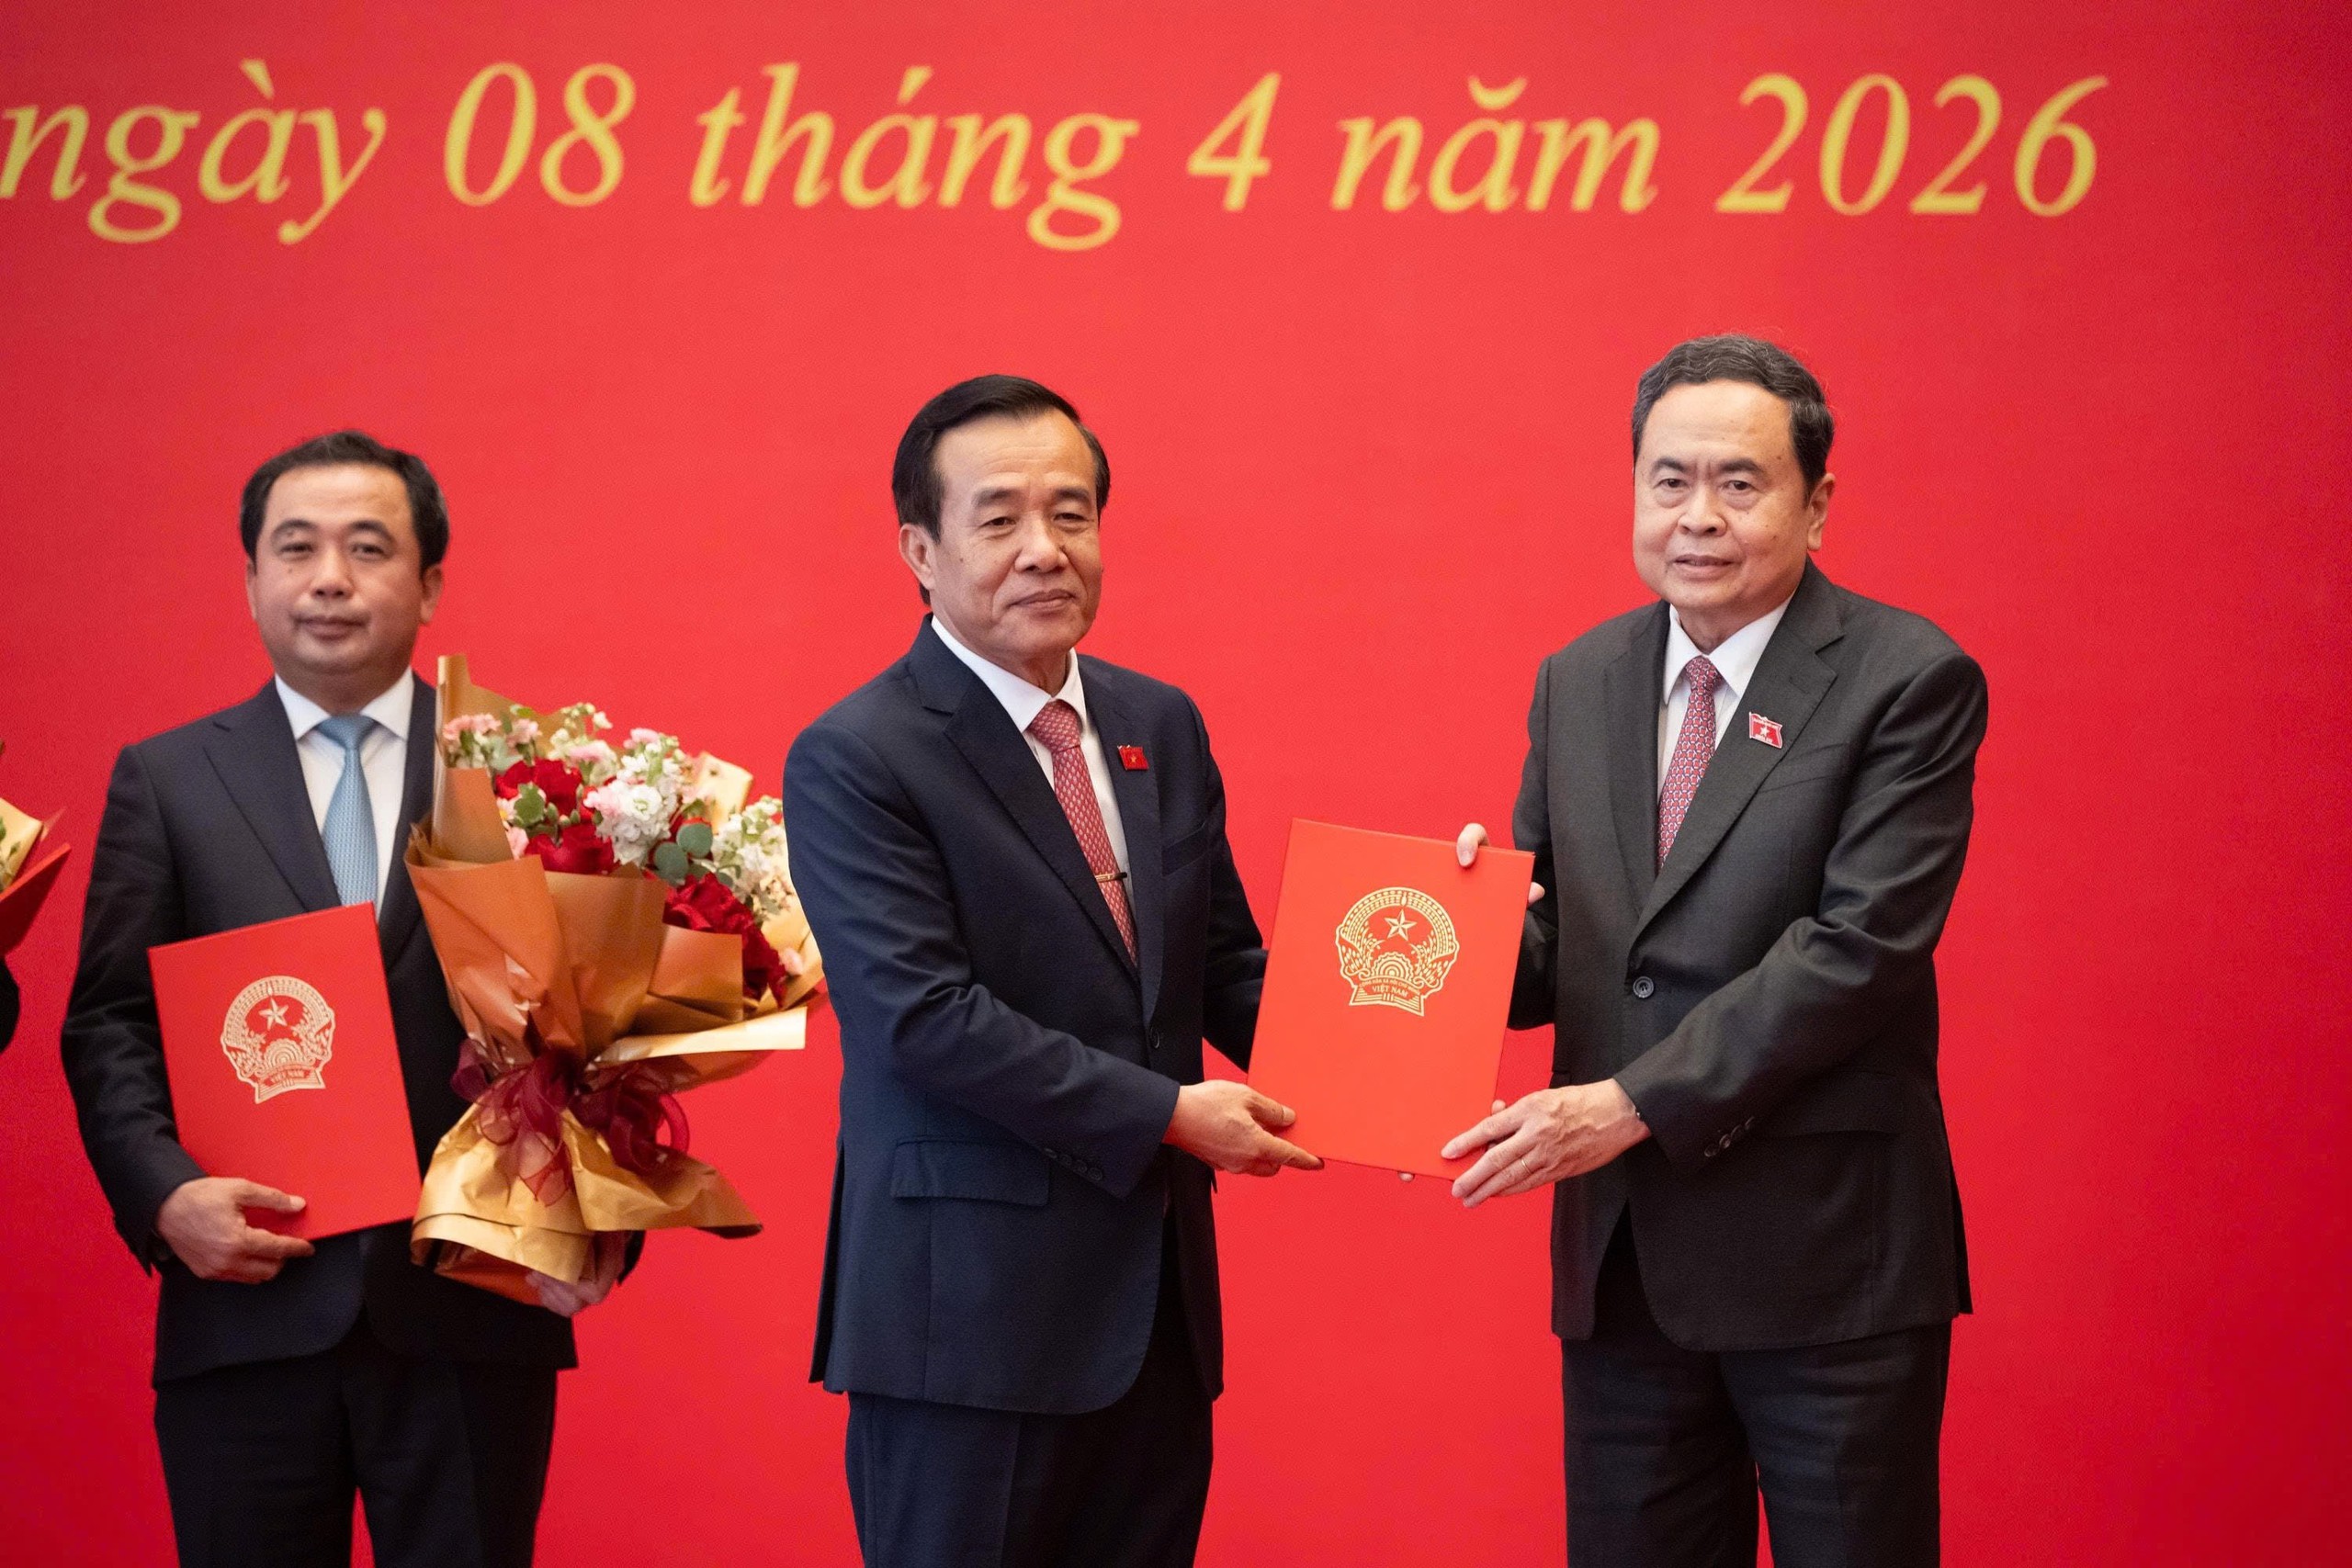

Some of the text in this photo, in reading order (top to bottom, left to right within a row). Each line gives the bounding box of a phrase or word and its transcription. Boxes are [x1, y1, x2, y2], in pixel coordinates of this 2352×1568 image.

[0, 59, 2108, 252] ngày 08 tháng 4 năm 2026
[1372, 983, 1390, 993] VIỆT
[1391, 986, 1408, 998] NAM
